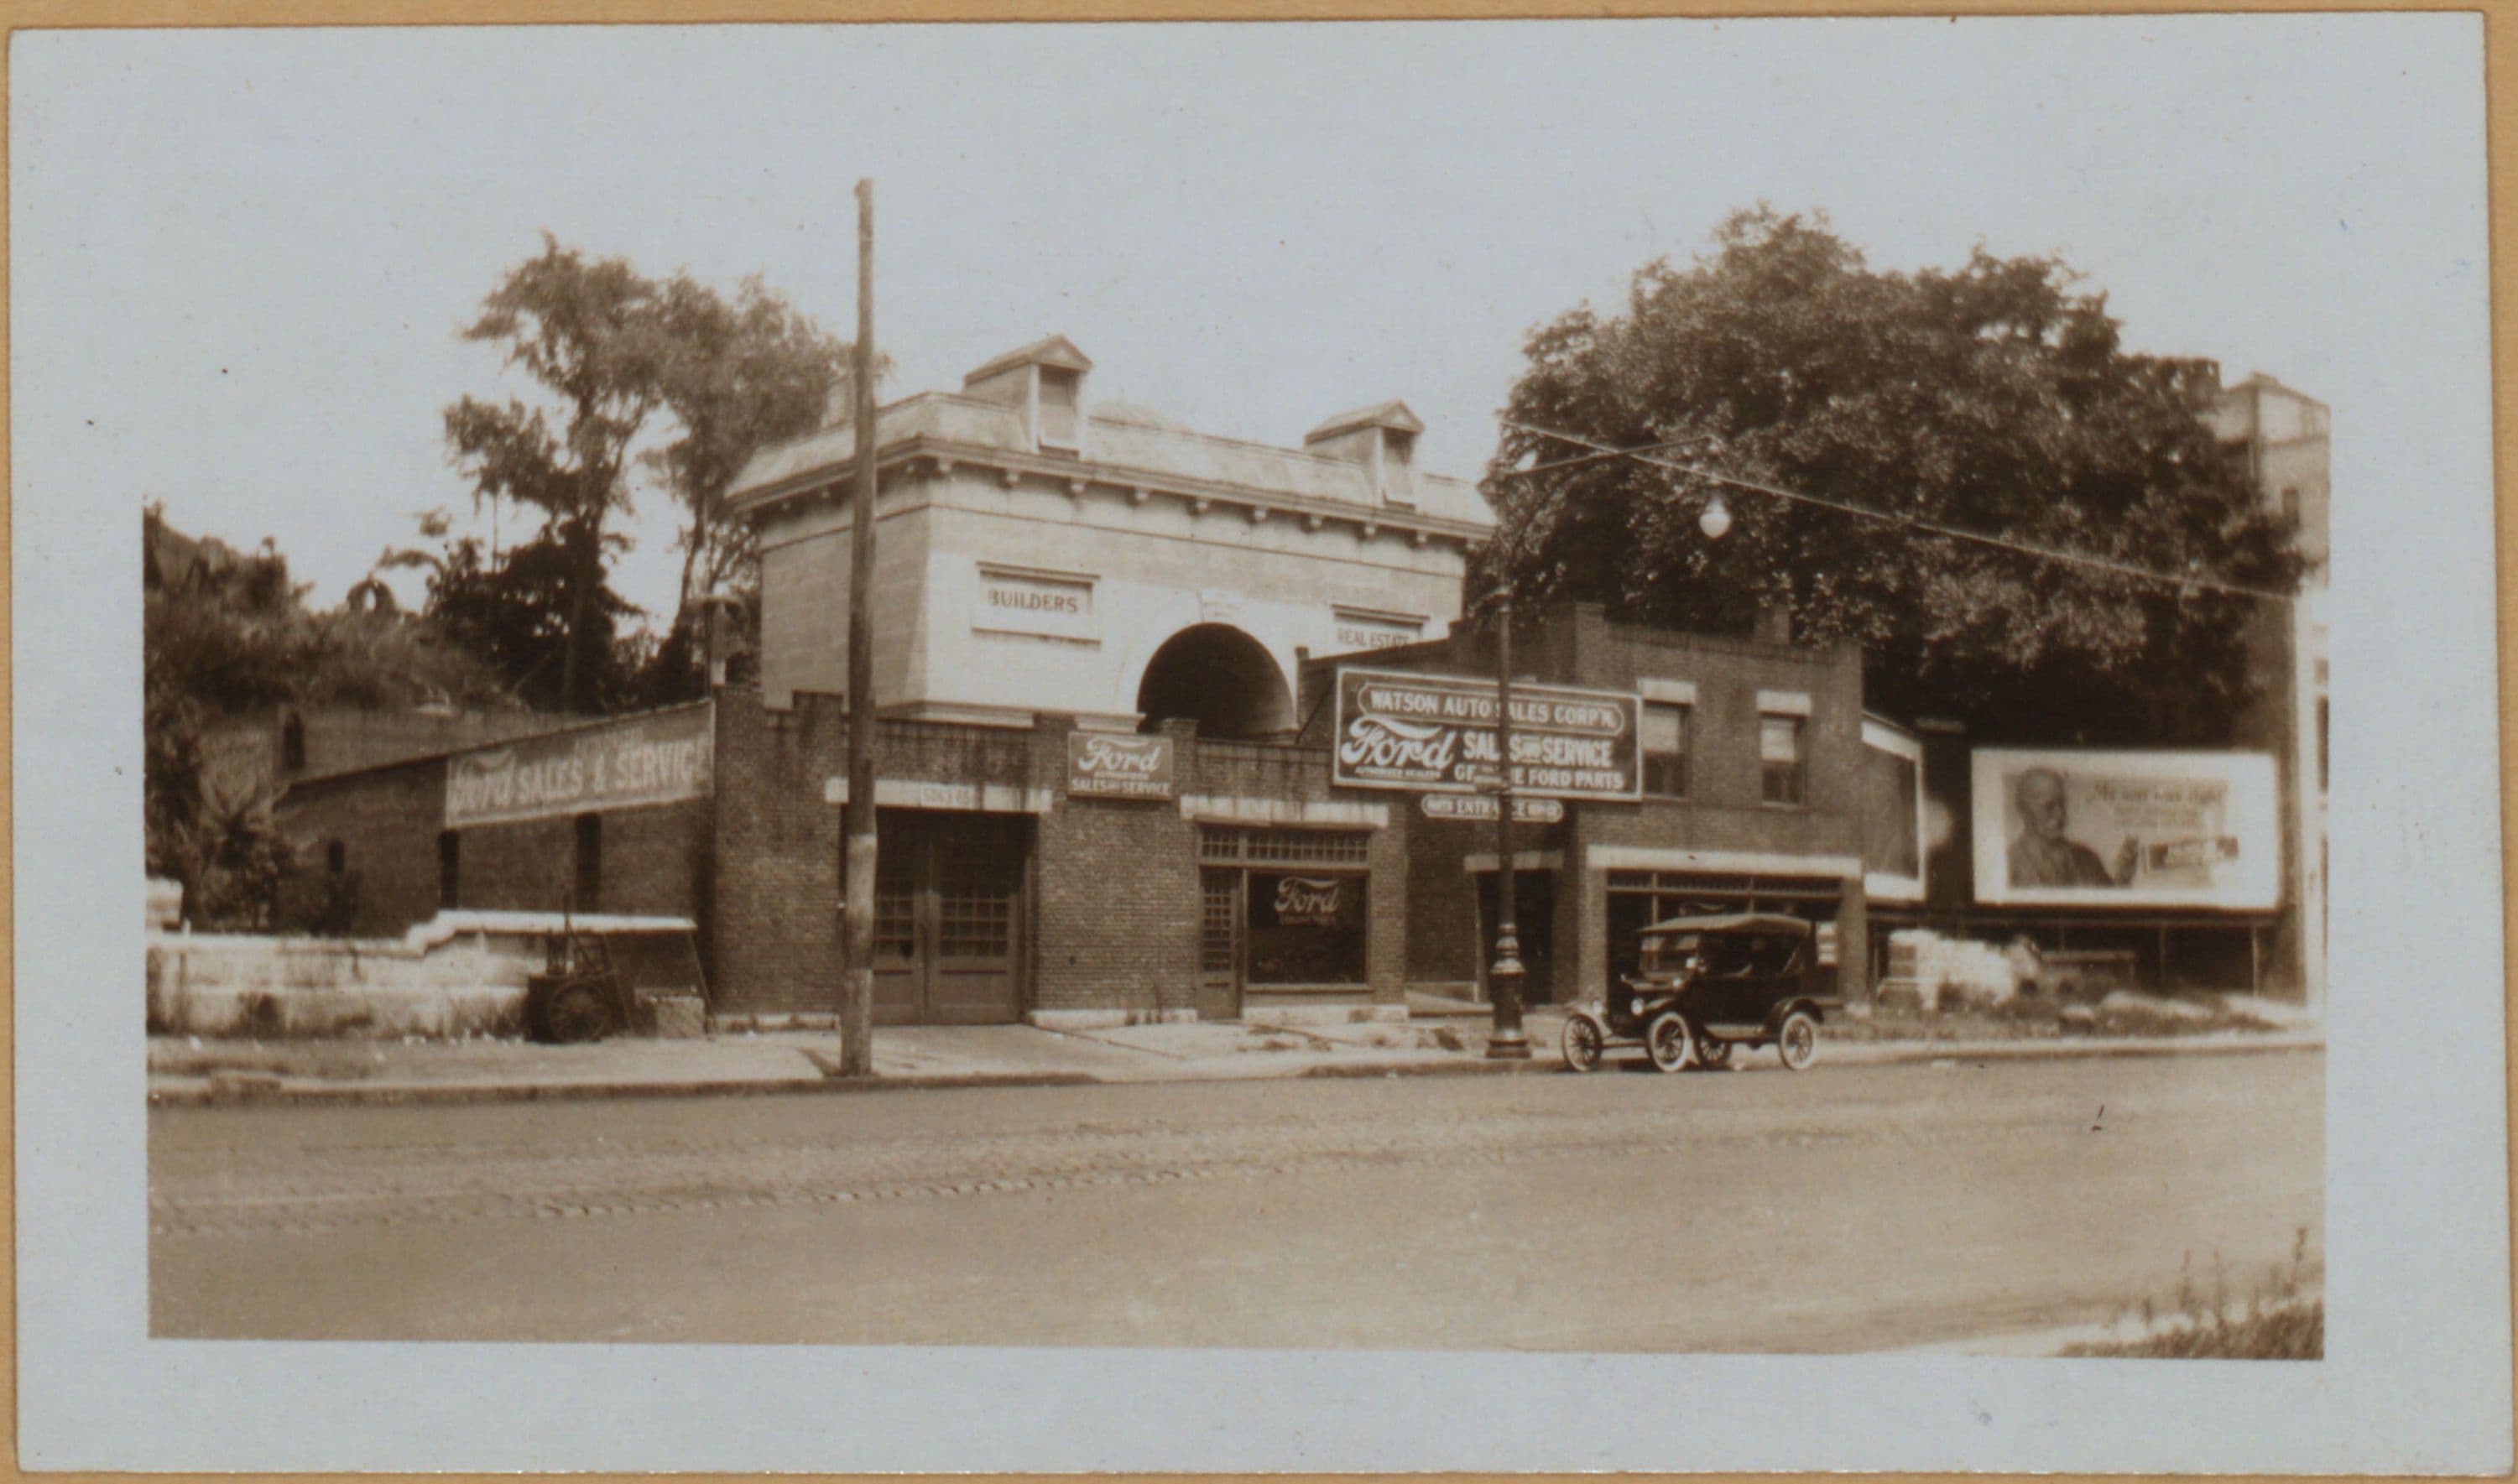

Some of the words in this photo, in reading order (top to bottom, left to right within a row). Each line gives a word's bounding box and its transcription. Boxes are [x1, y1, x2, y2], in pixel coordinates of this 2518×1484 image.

[988, 589, 1079, 613] BUILDERS
[1337, 627, 1365, 648] REAL
[1370, 690, 1438, 714] WATSON
[1443, 695, 1491, 719] AUTO
[1078, 737, 1161, 771] Ford
[1342, 713, 1457, 771] Ford
[1462, 731, 1521, 763] SALS
[1541, 737, 1612, 768] SERVICE
[519, 756, 584, 806] SALES
[593, 751, 611, 794] &
[1071, 778, 1107, 793] SALES
[1122, 780, 1169, 797] SERVICE
[1529, 768, 1572, 787] FORD
[1575, 770, 1625, 790] PARTS
[1275, 876, 1340, 913] Ford
